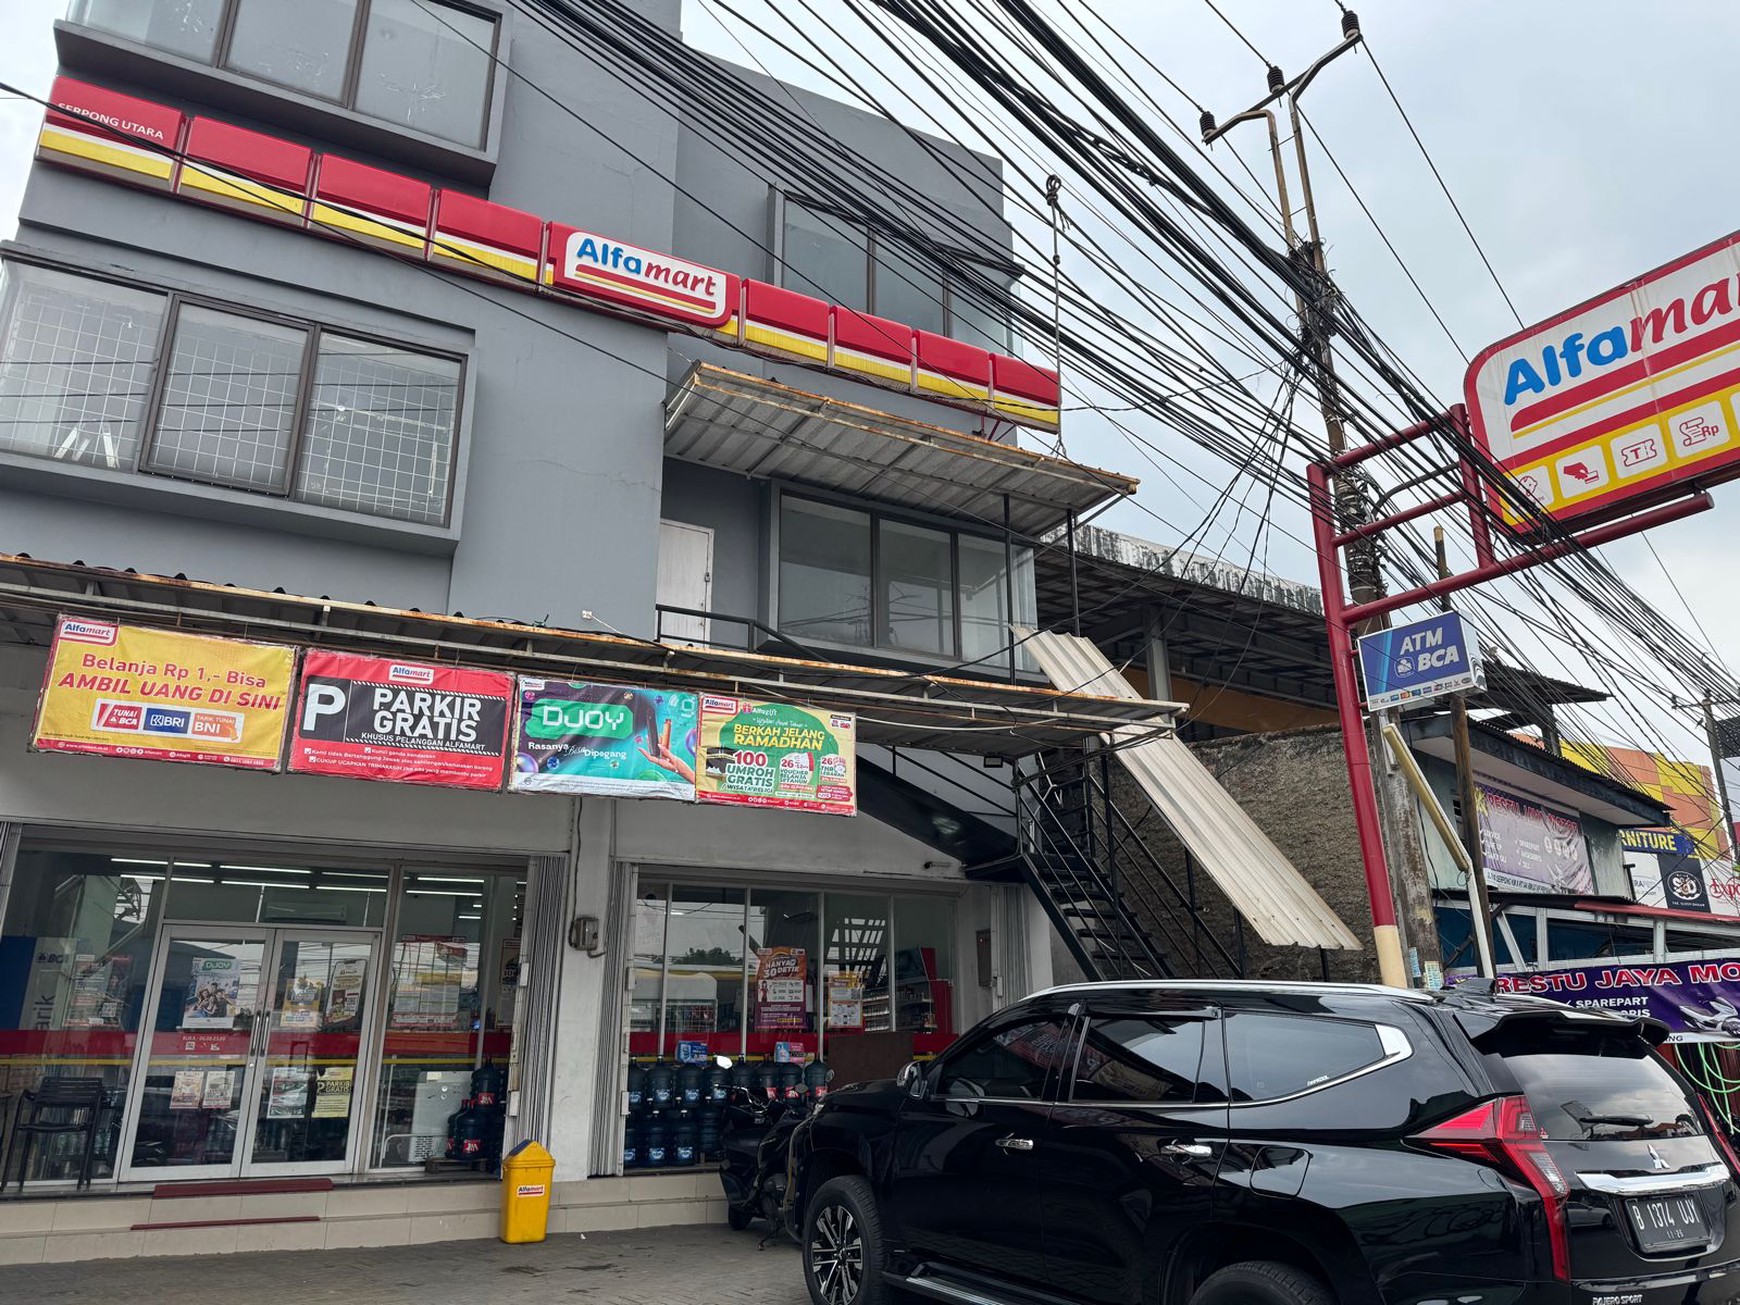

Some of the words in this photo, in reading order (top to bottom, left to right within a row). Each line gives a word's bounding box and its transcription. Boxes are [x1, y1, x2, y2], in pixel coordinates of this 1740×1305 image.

[122, 120, 164, 140] UTARA
[575, 238, 717, 297] Alfamart
[1503, 272, 1740, 406] Alfama
[1702, 425, 1720, 438] Rp
[1629, 446, 1642, 460] T
[64, 622, 112, 636] Alfamart
[1400, 627, 1443, 655] ATM
[1418, 645, 1460, 672] BCA
[82, 653, 157, 677] Belanja
[163, 663, 190, 681] Rp
[197, 667, 220, 682] 1,-
[226, 670, 267, 688] Bisa
[392, 666, 432, 678] Alfamart
[58, 672, 132, 694] AMBIL
[140, 681, 203, 701] UANG
[208, 688, 232, 704] DI
[236, 692, 281, 710] SINI
[302, 683, 347, 731] P
[373, 687, 482, 721] PARKIR
[704, 698, 735, 709] Alfamart
[113, 709, 138, 718] TUNAI
[197, 715, 214, 723] TARIK
[542, 705, 624, 731] DJOY
[119, 717, 138, 726] BCA
[164, 716, 186, 728] BRI
[194, 721, 221, 734] BNI
[373, 709, 478, 743] GRATIS
[733, 723, 782, 736] BERKAH
[782, 727, 826, 740] JELANG
[361, 732, 394, 742] KHUSUS
[396, 735, 443, 747] PELANGGAN
[444, 741, 486, 751] ALFAMART
[733, 734, 824, 751] RAMADHAN
[344, 752, 382, 762] Bertanggung
[528, 742, 569, 753] Rasanya
[584, 749, 628, 760] Dipegang
[734, 751, 768, 767] 100
[781, 758, 794, 768] 26
[821, 757, 833, 765] 26
[726, 764, 775, 778] UMROH
[780, 768, 809, 776] VOUCHER
[726, 774, 774, 788] GRATIS
[727, 784, 753, 792] WISATA
[753, 786, 774, 794] RELIGI
[205, 960, 231, 969] DJOY
[763, 968, 777, 978] 30
[777, 966, 800, 974] DETIK
[1494, 972, 1586, 994] RESTU
[1596, 967, 1684, 988] JAYA
[1575, 996, 1649, 1009] SPAREPART
[33, 994, 56, 1030] arik
[1620, 1008, 1651, 1018] ORIS
[1632, 1205, 1645, 1230] B
[1646, 1202, 1675, 1229] 1374
[1620, 1294, 1643, 1304] SPORT
